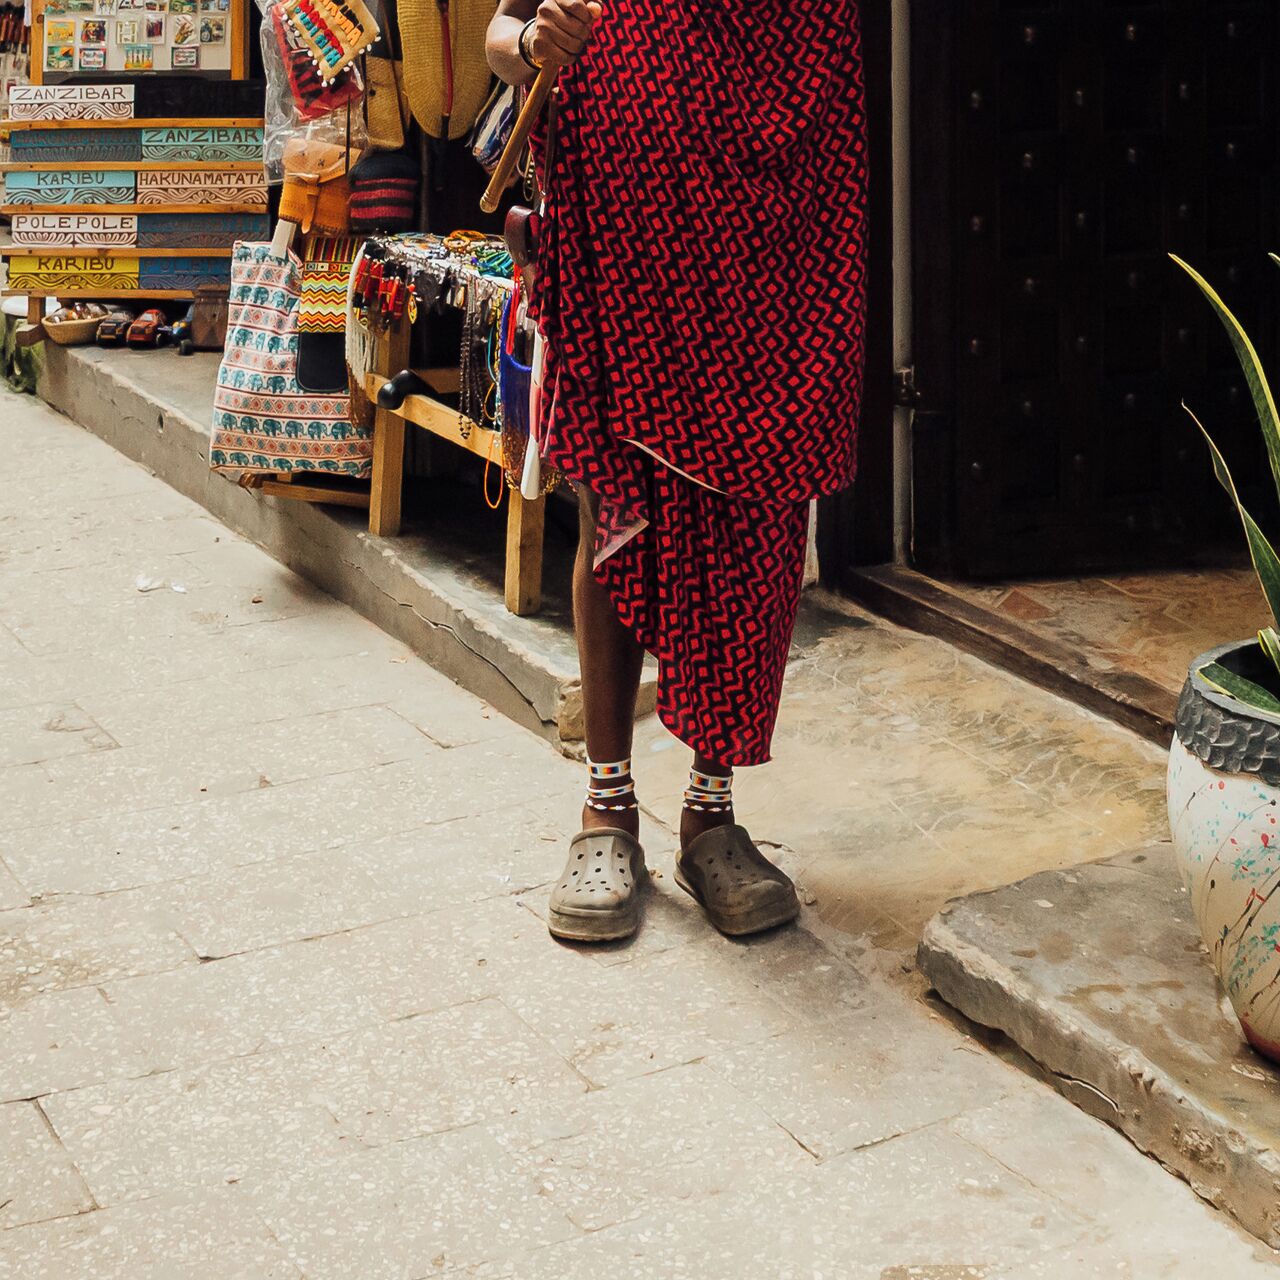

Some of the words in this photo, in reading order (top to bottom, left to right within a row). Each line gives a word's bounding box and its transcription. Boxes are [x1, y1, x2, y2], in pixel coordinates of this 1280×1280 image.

[13, 87, 126, 100] ZANZIBAR
[144, 128, 260, 144] ZANZIBAR
[37, 172, 105, 186] KARIBU
[37, 256, 115, 271] KARIBU
